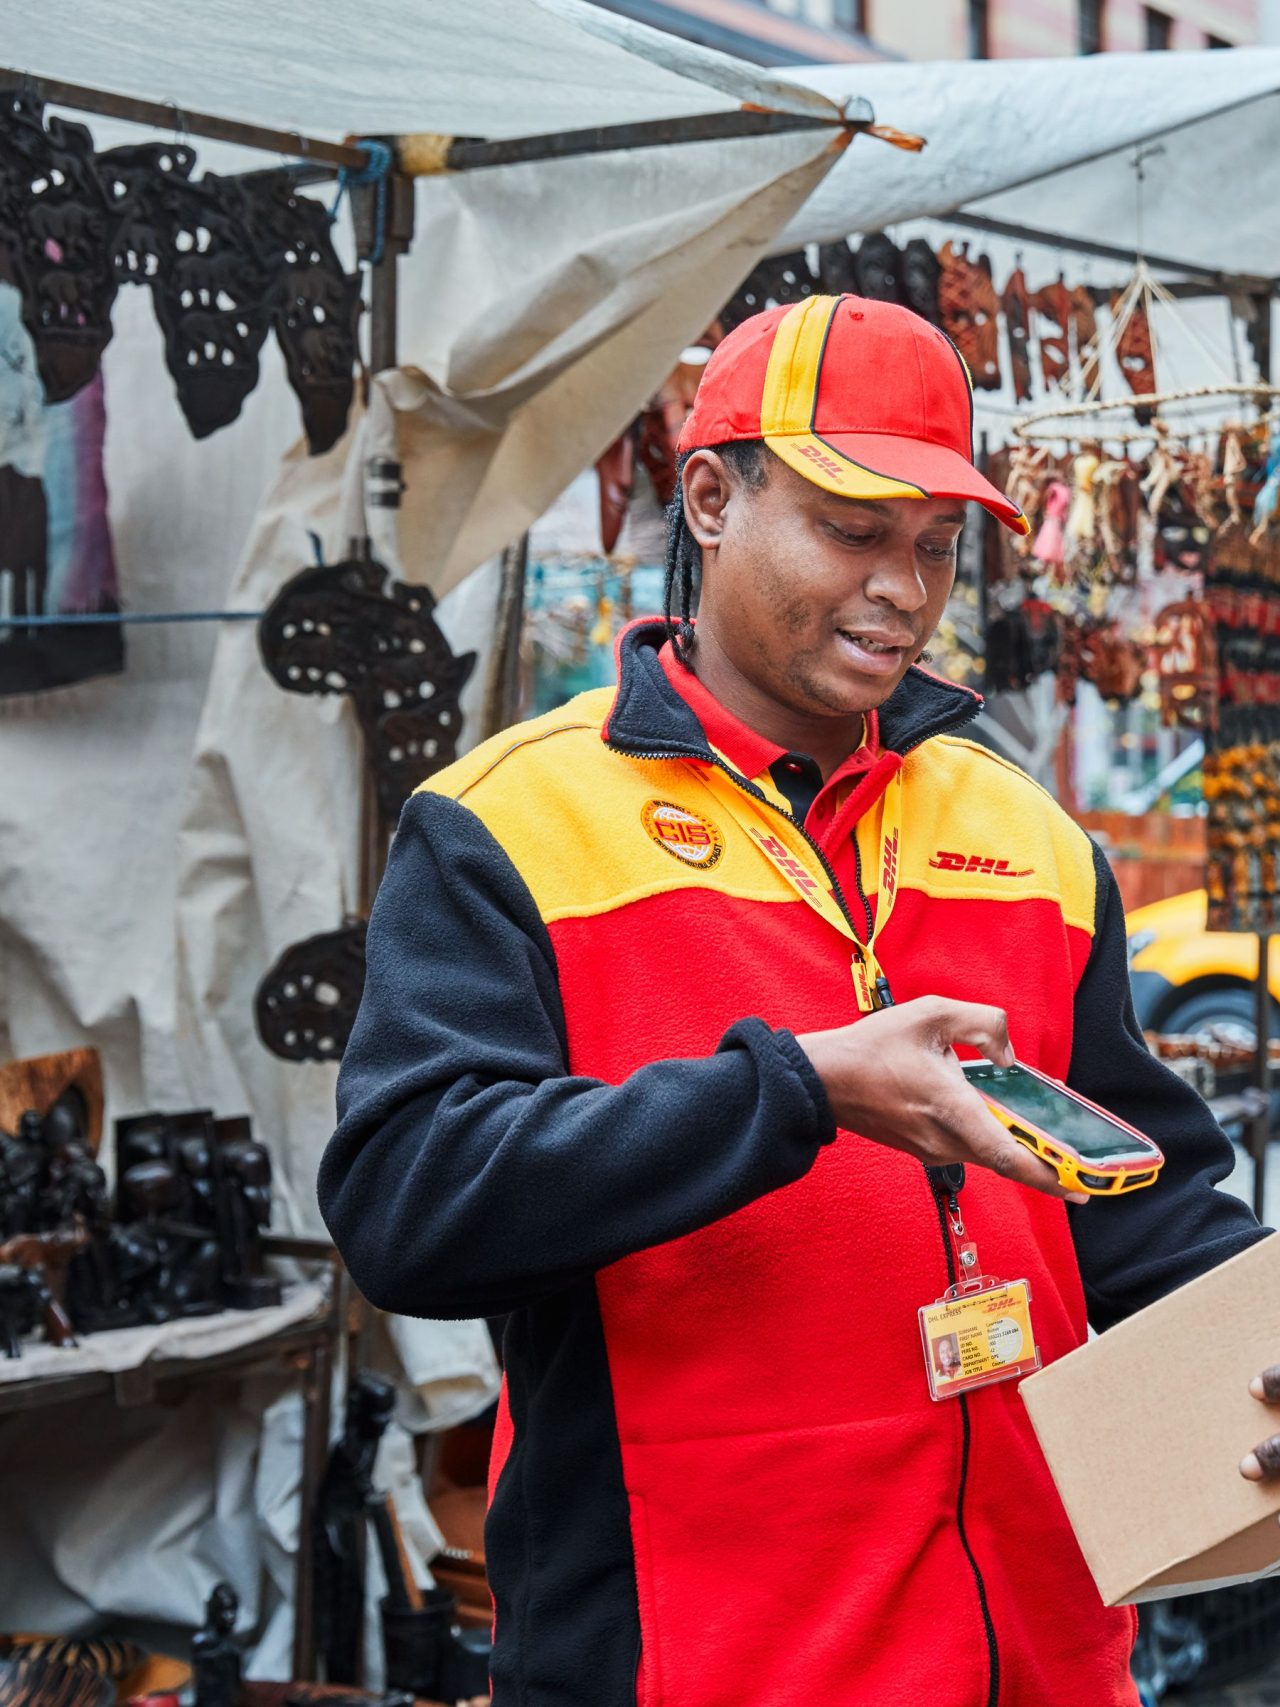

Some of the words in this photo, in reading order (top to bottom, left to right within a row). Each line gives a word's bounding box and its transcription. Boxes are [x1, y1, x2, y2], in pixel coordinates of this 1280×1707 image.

[798, 445, 844, 478] DHL
[654, 821, 711, 845] CIS
[759, 836, 818, 896] DHL
[883, 835, 898, 895] DHL
[935, 851, 1018, 877] DHL
[940, 1308, 962, 1320] EXPRESS
